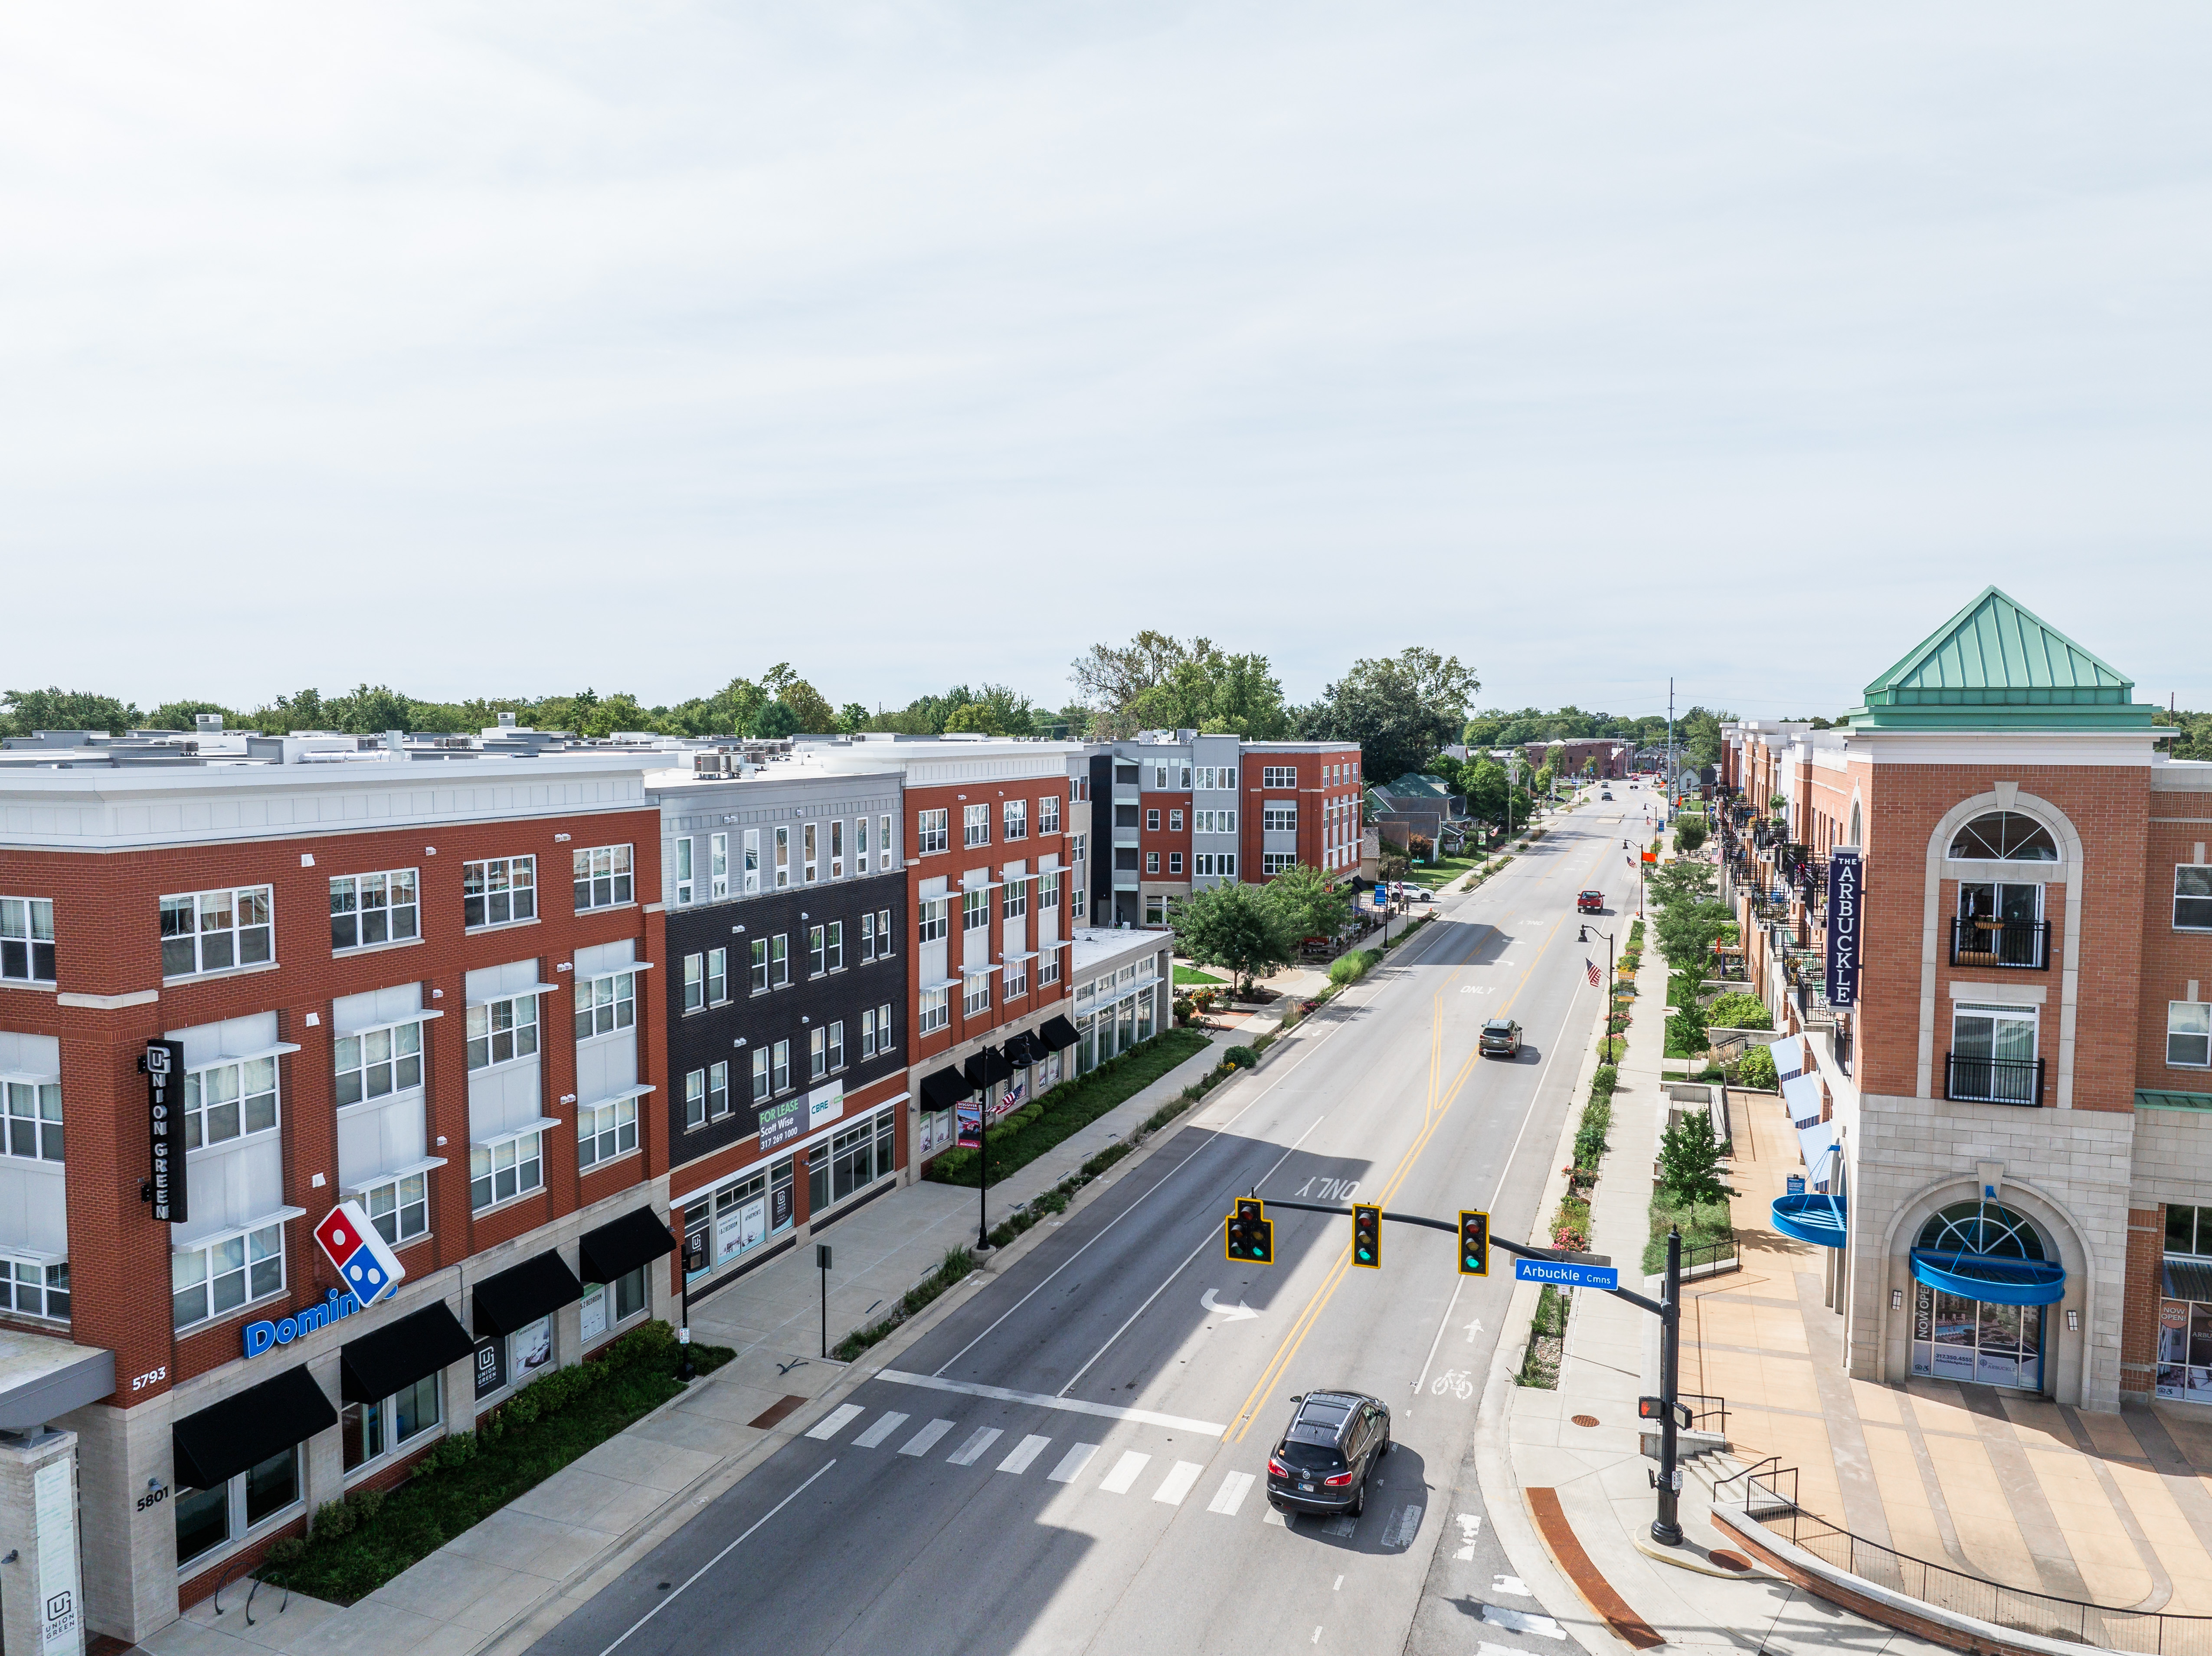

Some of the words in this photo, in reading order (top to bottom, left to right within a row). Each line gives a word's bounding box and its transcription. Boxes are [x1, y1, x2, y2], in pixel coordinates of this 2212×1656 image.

[1836, 866, 1855, 1003] ARBUCKLE
[1460, 985, 1496, 994] ONLY
[760, 1108, 776, 1125] FOR
[777, 1099, 798, 1117] LEASE
[812, 1100, 828, 1114] CBRE
[761, 1123, 777, 1137] Scott
[778, 1117, 794, 1130] Wise
[761, 1137, 772, 1150] 317
[772, 1133, 783, 1145] 269
[785, 1126, 798, 1139] 1000
[155, 1142, 170, 1219] GREEN
[1294, 1176, 1360, 1201] ONLY
[745, 1209, 761, 1222] APARTMENTS
[725, 1221, 738, 1231] BEDROOM
[1522, 1265, 1580, 1280] Arbuckle
[1587, 1274, 1610, 1284] Cmns
[586, 1293, 602, 1306] BEDROOM
[242, 1288, 398, 1359] Domin
[1918, 1310, 1929, 1338] NOW
[1936, 1353, 1973, 1362] 317.350.4555
[132, 1366, 166, 1391] 5793
[478, 1365, 496, 1379] UNION
[478, 1371, 496, 1385] GREEN
[137, 1486, 169, 1512] 5801
[46, 1613, 74, 1632] UNION
[46, 1620, 75, 1639] GREEN
